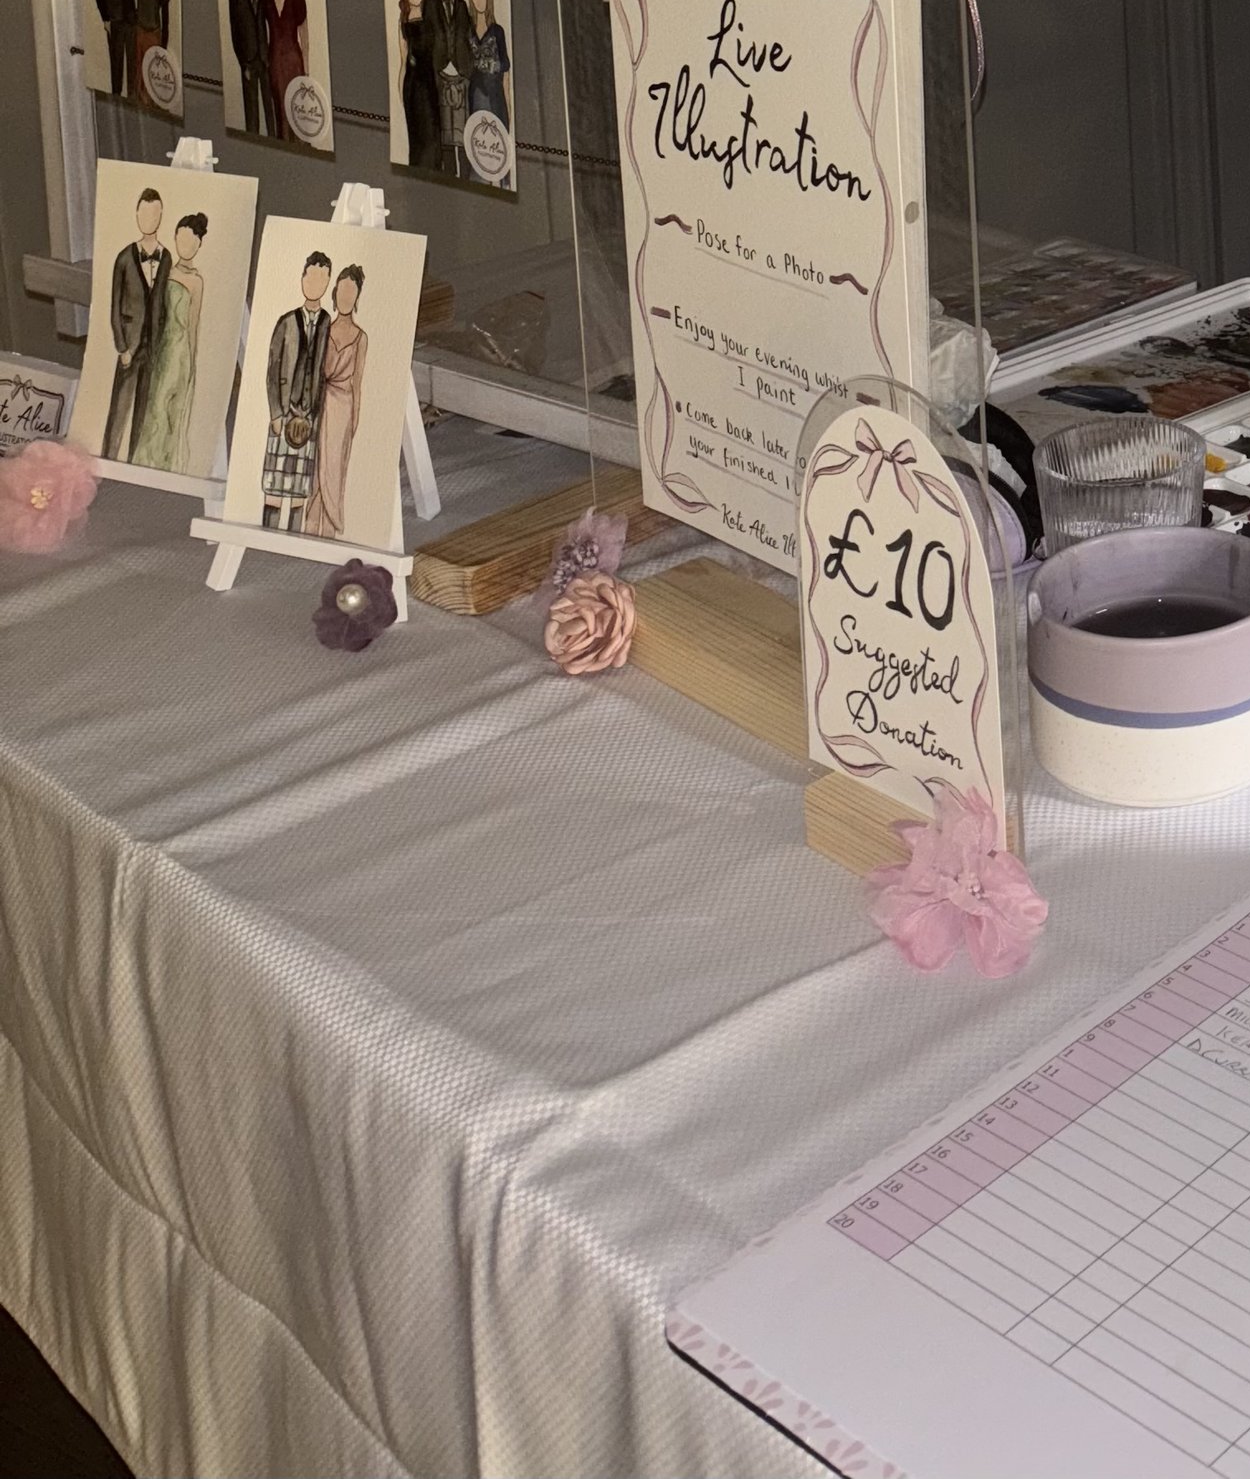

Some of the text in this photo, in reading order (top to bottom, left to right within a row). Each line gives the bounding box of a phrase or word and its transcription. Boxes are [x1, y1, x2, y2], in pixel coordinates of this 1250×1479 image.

[648, 63, 872, 202] Illustration
[696, 218, 825, 285] Pose for a Photo
[673, 305, 716, 351] Enjoy
[720, 330, 749, 358] your
[754, 346, 810, 393] evening
[737, 365, 797, 406] I paint
[13, 401, 53, 433] Alice
[685, 401, 791, 461] Come back later
[689, 434, 715, 458] your
[722, 447, 778, 487] finished
[720, 502, 747, 536] Kate
[748, 520, 780, 551] Alice
[823, 508, 956, 631] £10
[833, 615, 963, 705] Suggested
[845, 689, 964, 771] Donation
[1235, 922, 1246, 931] 1
[1217, 935, 1230, 945] 2
[1200, 949, 1211, 959] 3
[1183, 963, 1193, 972] 4
[1162, 976, 1174, 986] 5
[1143, 990, 1154, 999] 6
[1124, 1004, 1136, 1012] 7
[1103, 1019, 1116, 1028] 8
[1085, 1033, 1096, 1042] 9
[1042, 1065, 1060, 1078] 11
[1021, 1080, 1040, 1094] 12
[999, 1096, 1018, 1110] 13
[977, 1113, 996, 1126] 14
[954, 1128, 974, 1143] 15
[931, 1145, 951, 1159] 16
[907, 1162, 928, 1175] 17
[883, 1179, 904, 1193] 18
[859, 1196, 880, 1211] 19
[834, 1213, 855, 1229] 20
